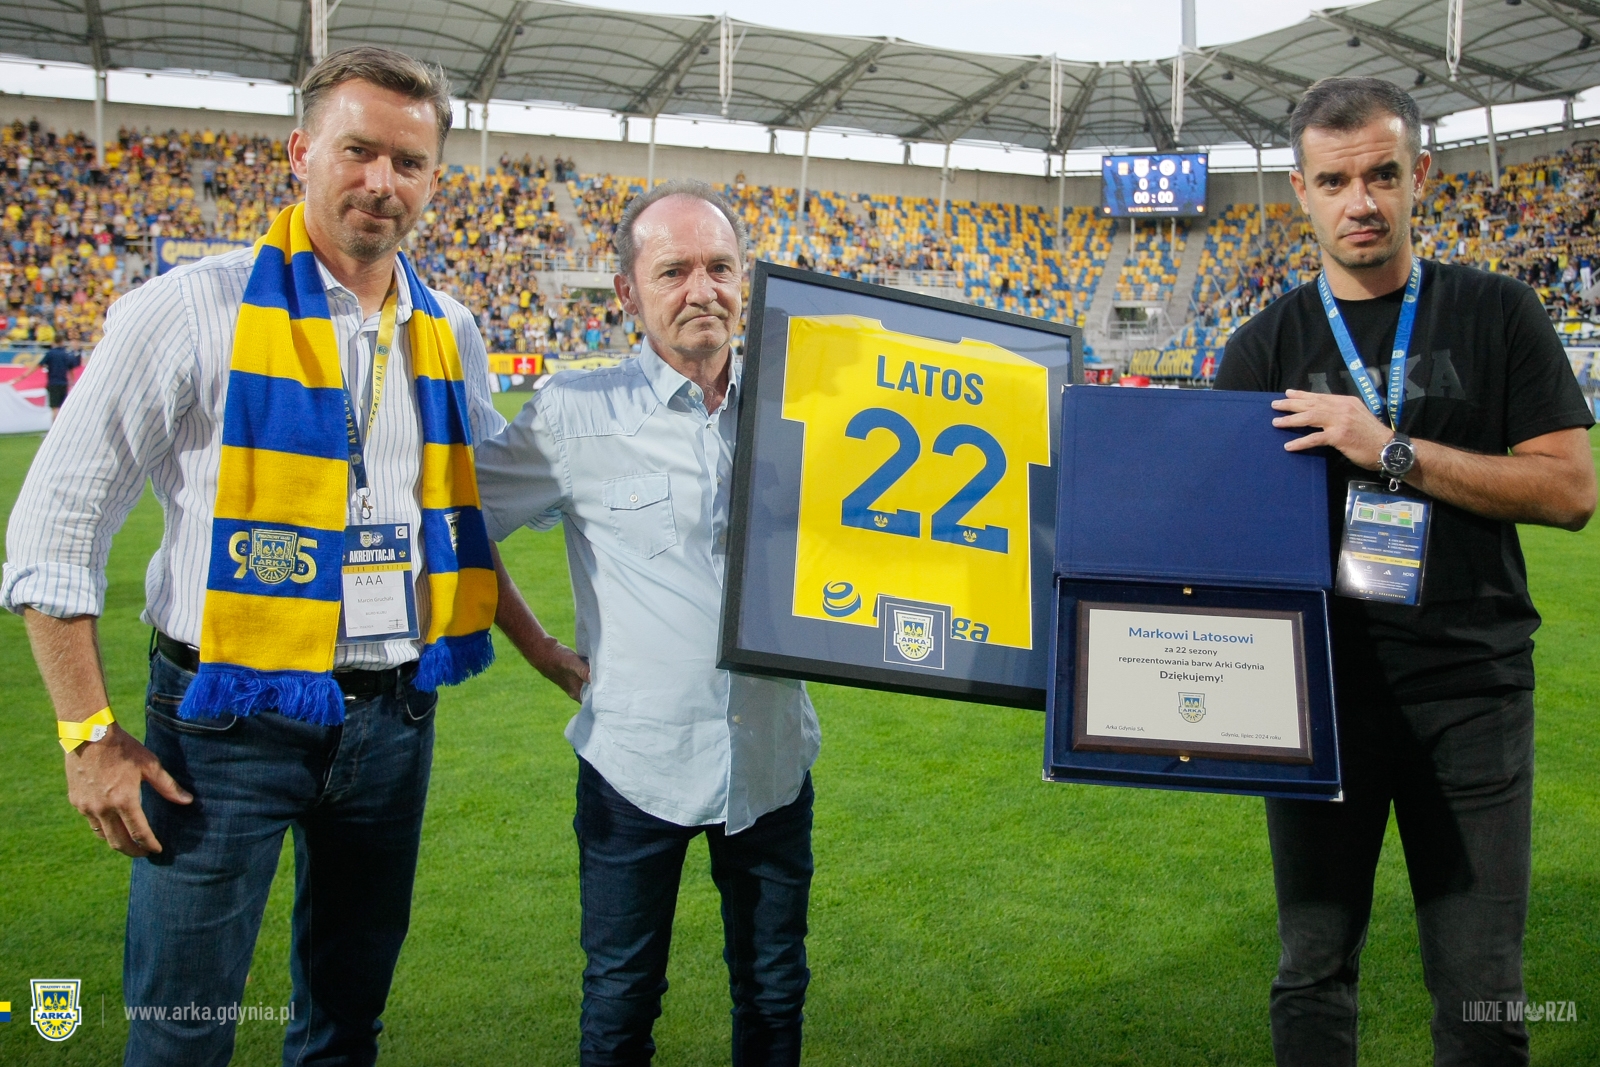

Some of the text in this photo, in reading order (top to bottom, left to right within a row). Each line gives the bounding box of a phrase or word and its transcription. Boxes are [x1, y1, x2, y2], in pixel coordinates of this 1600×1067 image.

[876, 355, 984, 405] LATOS
[840, 407, 1009, 555] 22
[257, 559, 287, 567] ARKA
[349, 548, 396, 563] AKREDYTACJA
[901, 637, 927, 645] ARKA
[1128, 626, 1254, 645] Markowi Latosowi
[1176, 646, 1187, 654] 22
[1188, 647, 1218, 657] sezony
[1118, 655, 1265, 671] reprezentowania barw Arki Gdynia
[1159, 670, 1224, 684] Dziękujemy!
